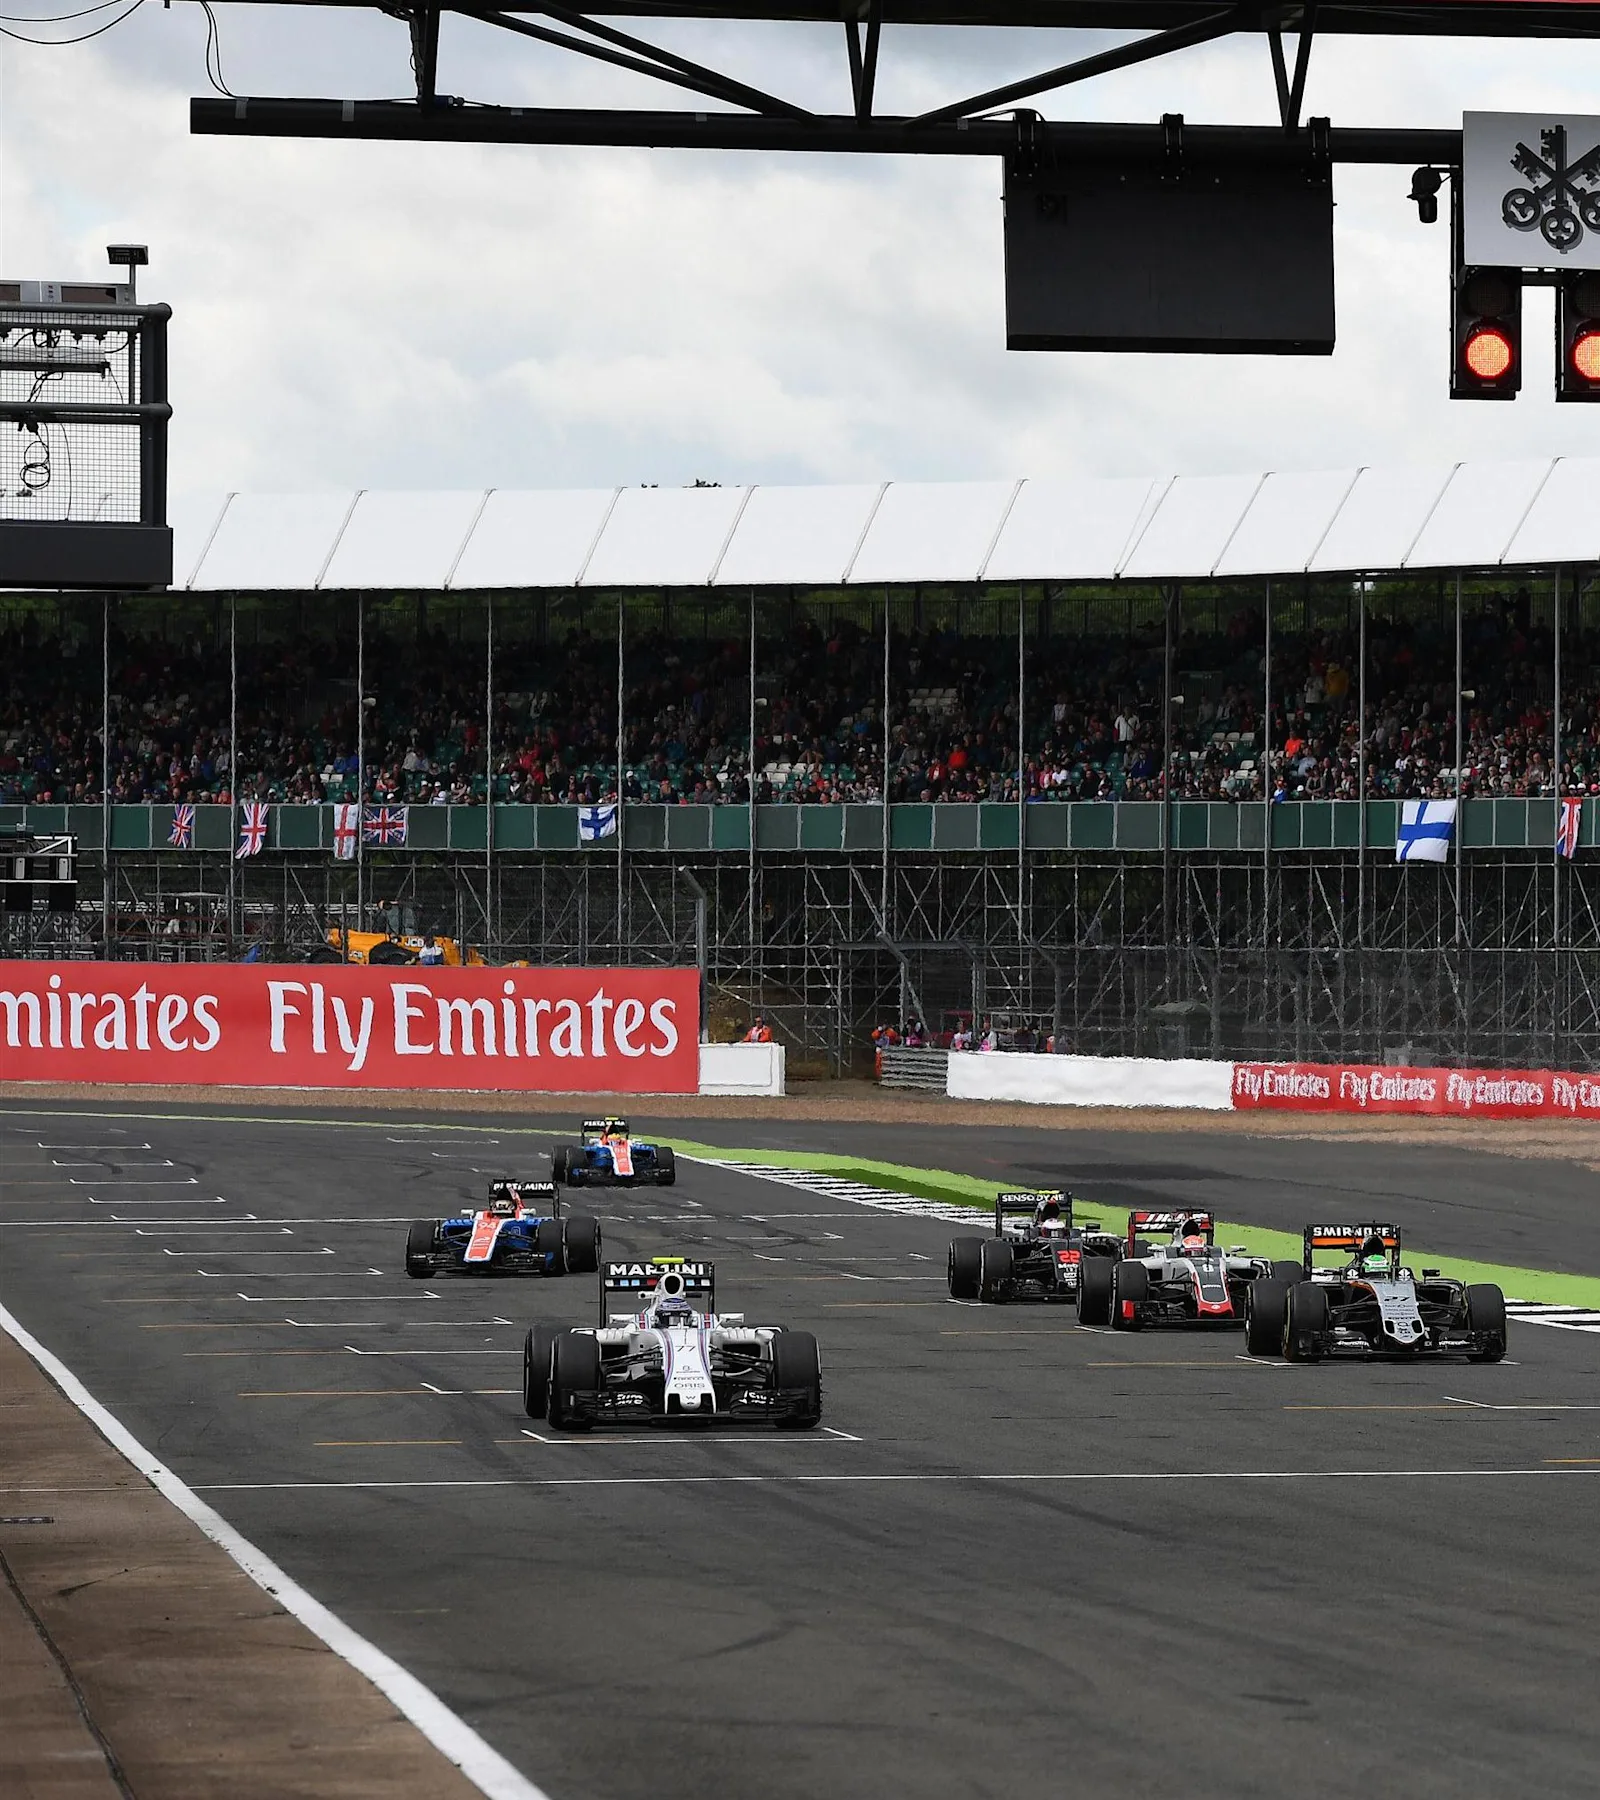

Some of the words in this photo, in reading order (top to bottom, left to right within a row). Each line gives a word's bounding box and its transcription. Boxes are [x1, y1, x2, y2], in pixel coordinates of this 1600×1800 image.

[405, 936, 425, 948] JCB
[0, 976, 220, 1051] mirates
[268, 981, 374, 1072] Fly
[390, 980, 679, 1058] Emirates
[1002, 1193, 1065, 1202] SENSODYNE
[1313, 1227, 1390, 1237] SMIRNOF
[1057, 1250, 1081, 1264] 22
[610, 1264, 704, 1275] MARTINI
